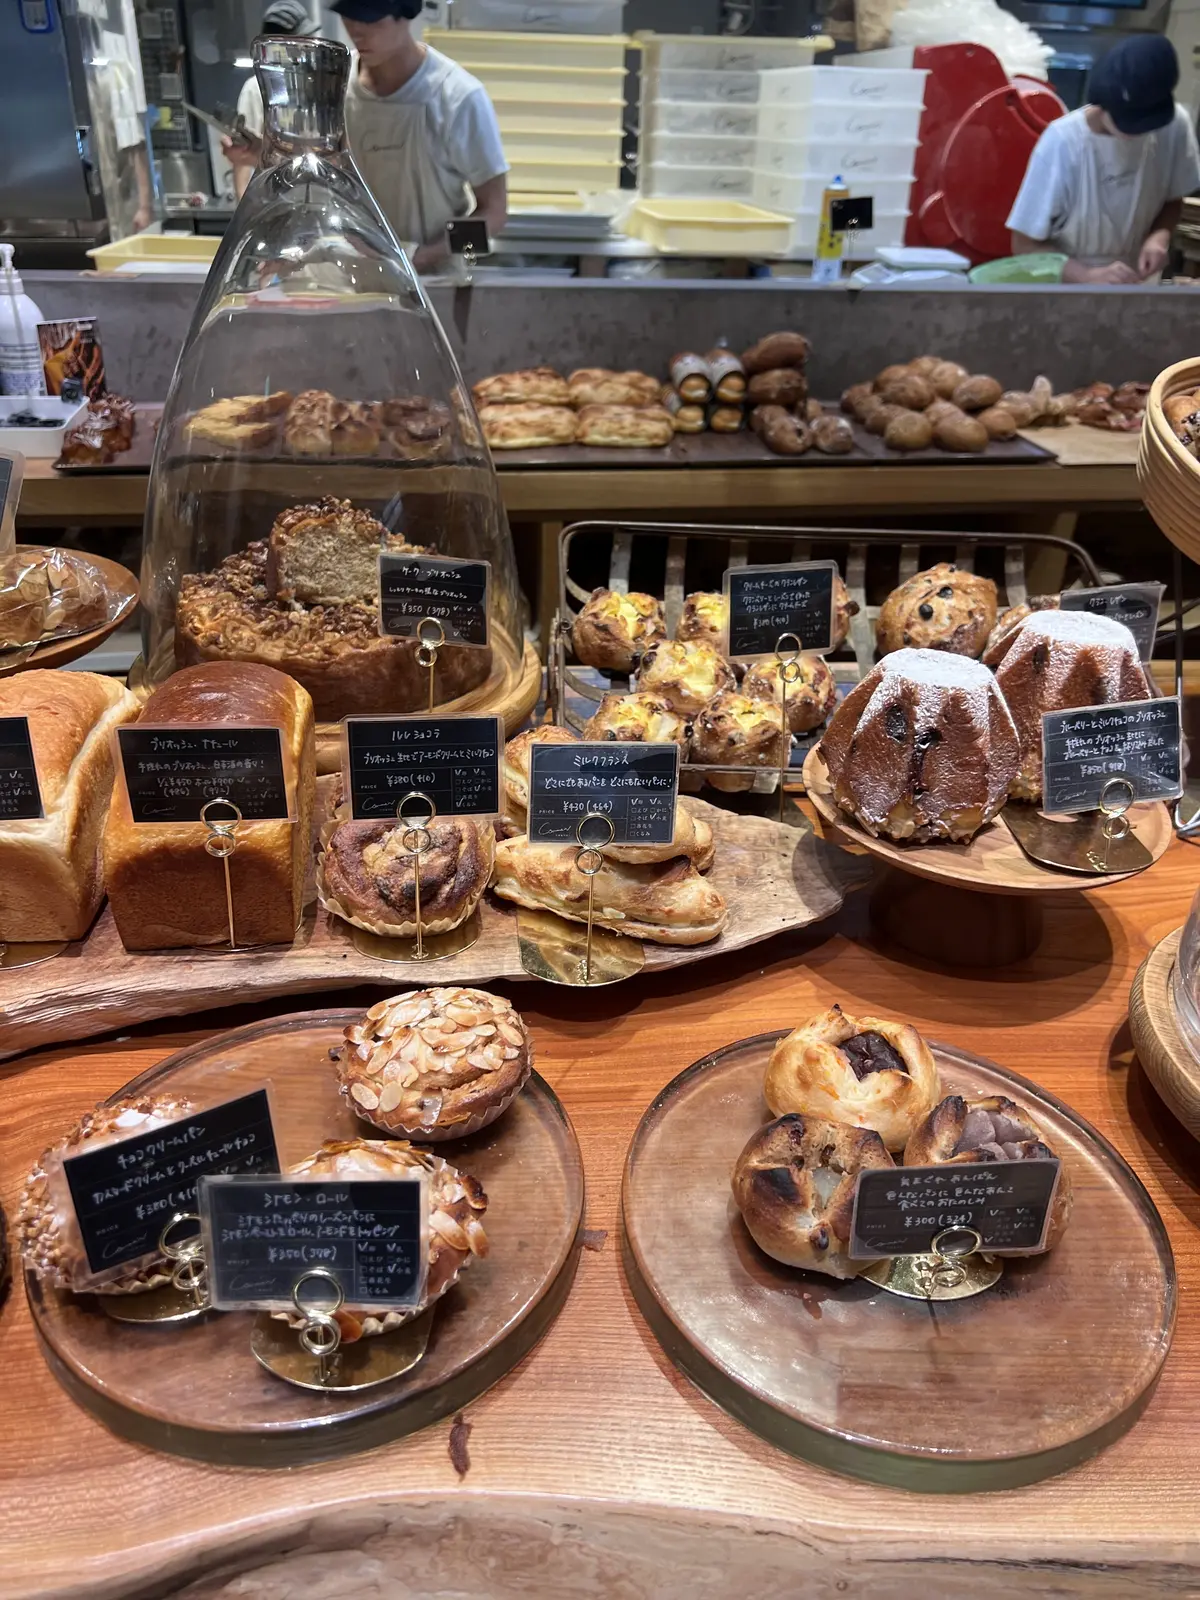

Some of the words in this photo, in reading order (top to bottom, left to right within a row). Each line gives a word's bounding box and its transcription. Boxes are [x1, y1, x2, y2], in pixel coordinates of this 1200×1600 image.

[401, 602, 423, 615] ¥350
[426, 606, 451, 617] (378)
[573, 753, 630, 767] ミルクフランス
